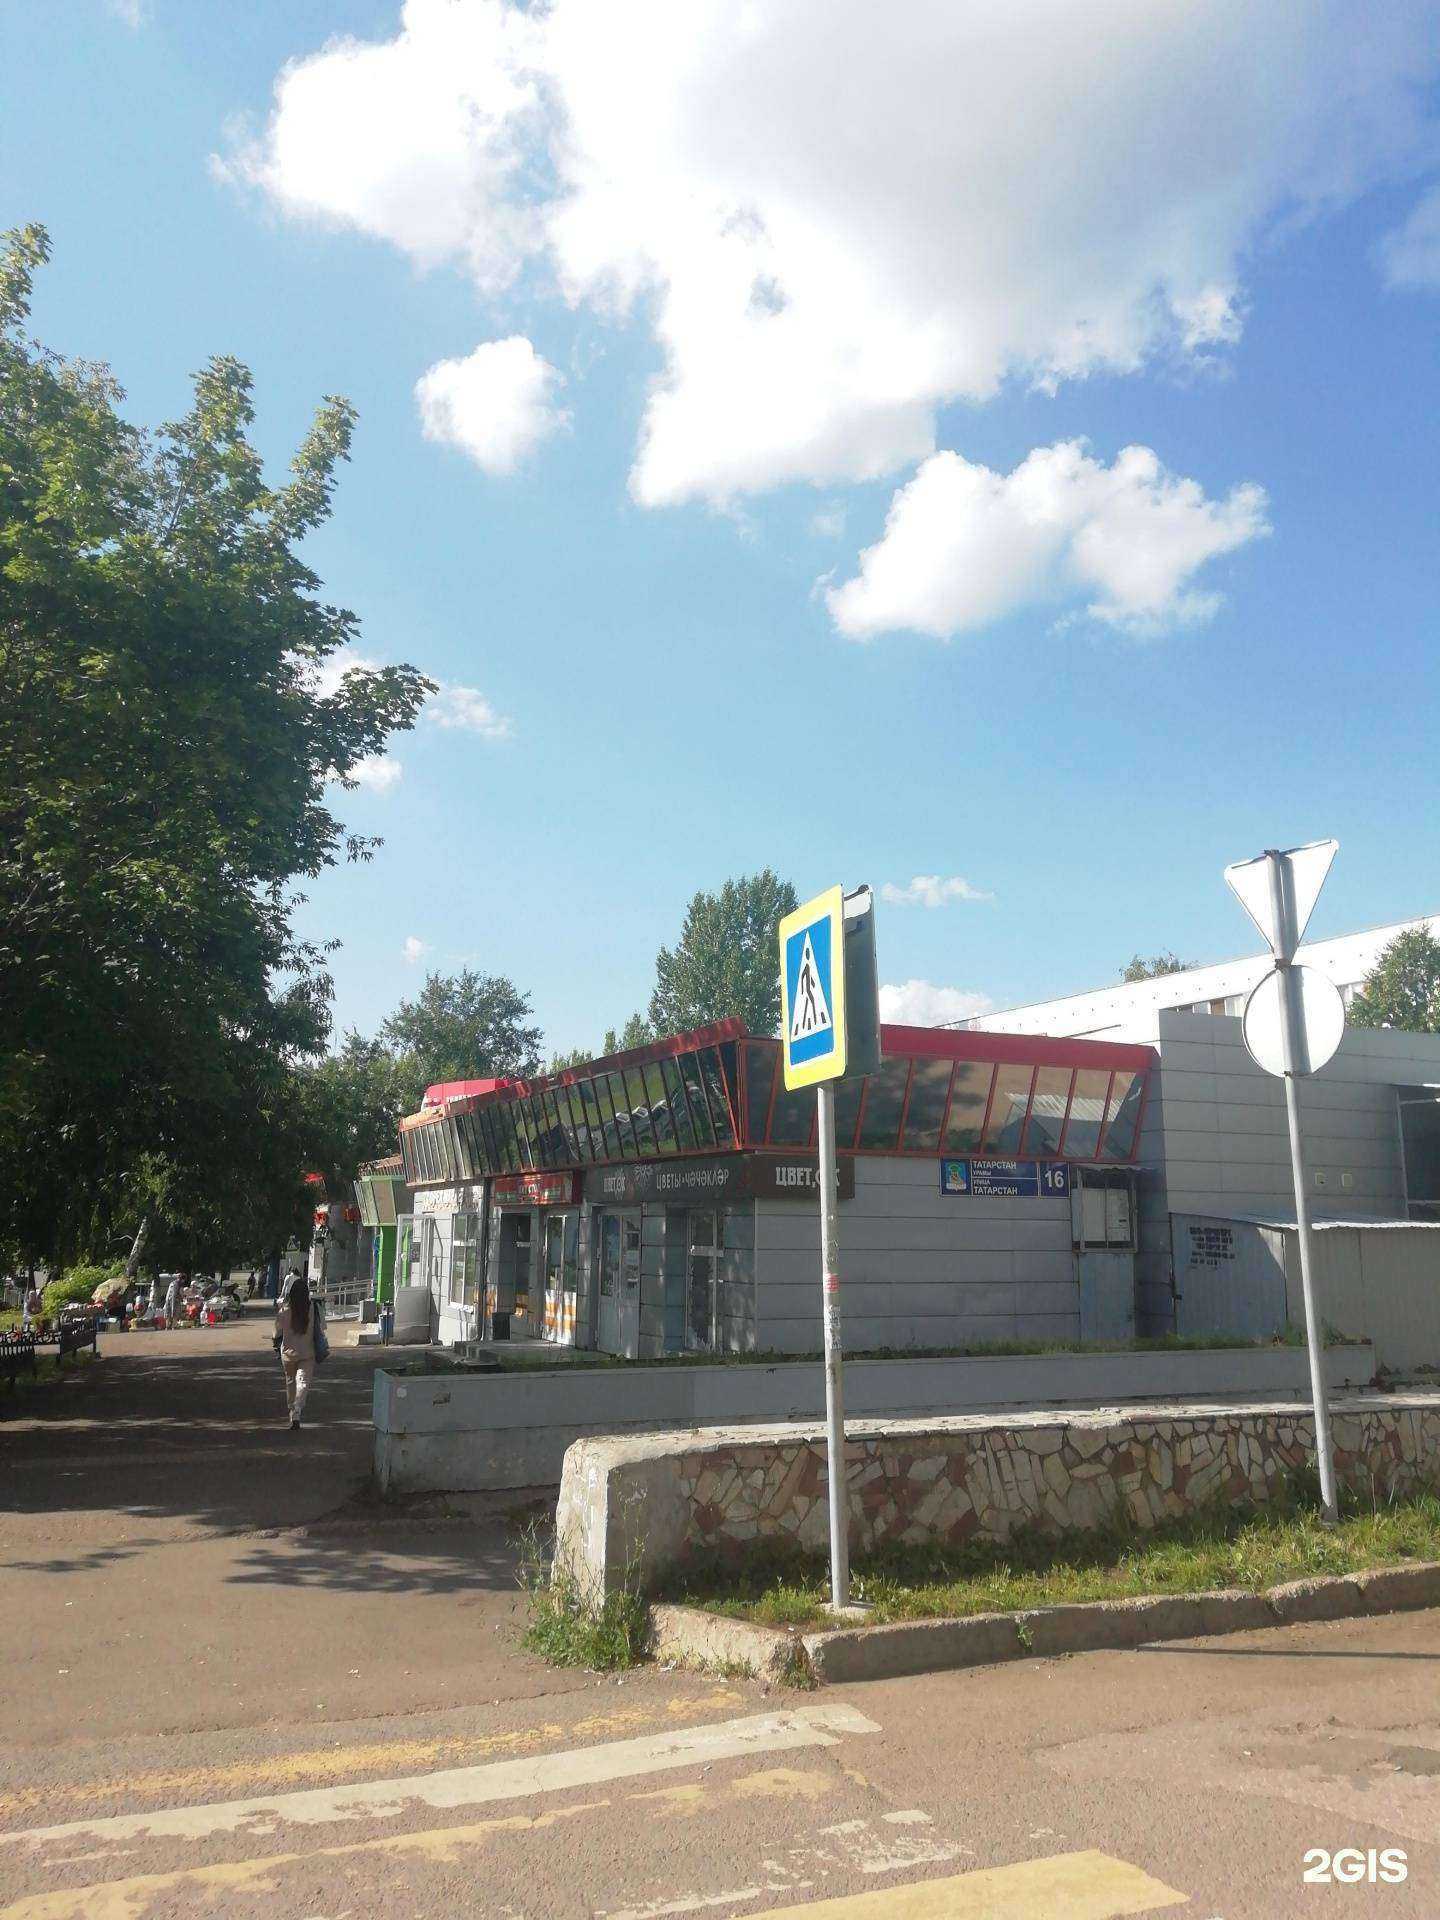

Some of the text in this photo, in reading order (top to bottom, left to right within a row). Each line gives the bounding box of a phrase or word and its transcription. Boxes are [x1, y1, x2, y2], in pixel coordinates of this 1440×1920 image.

[972, 1161, 1017, 1170] ТАТАРСТАН
[1044, 1170, 1064, 1188] 16
[973, 1186, 1018, 1195] ТАТАРСТАН
